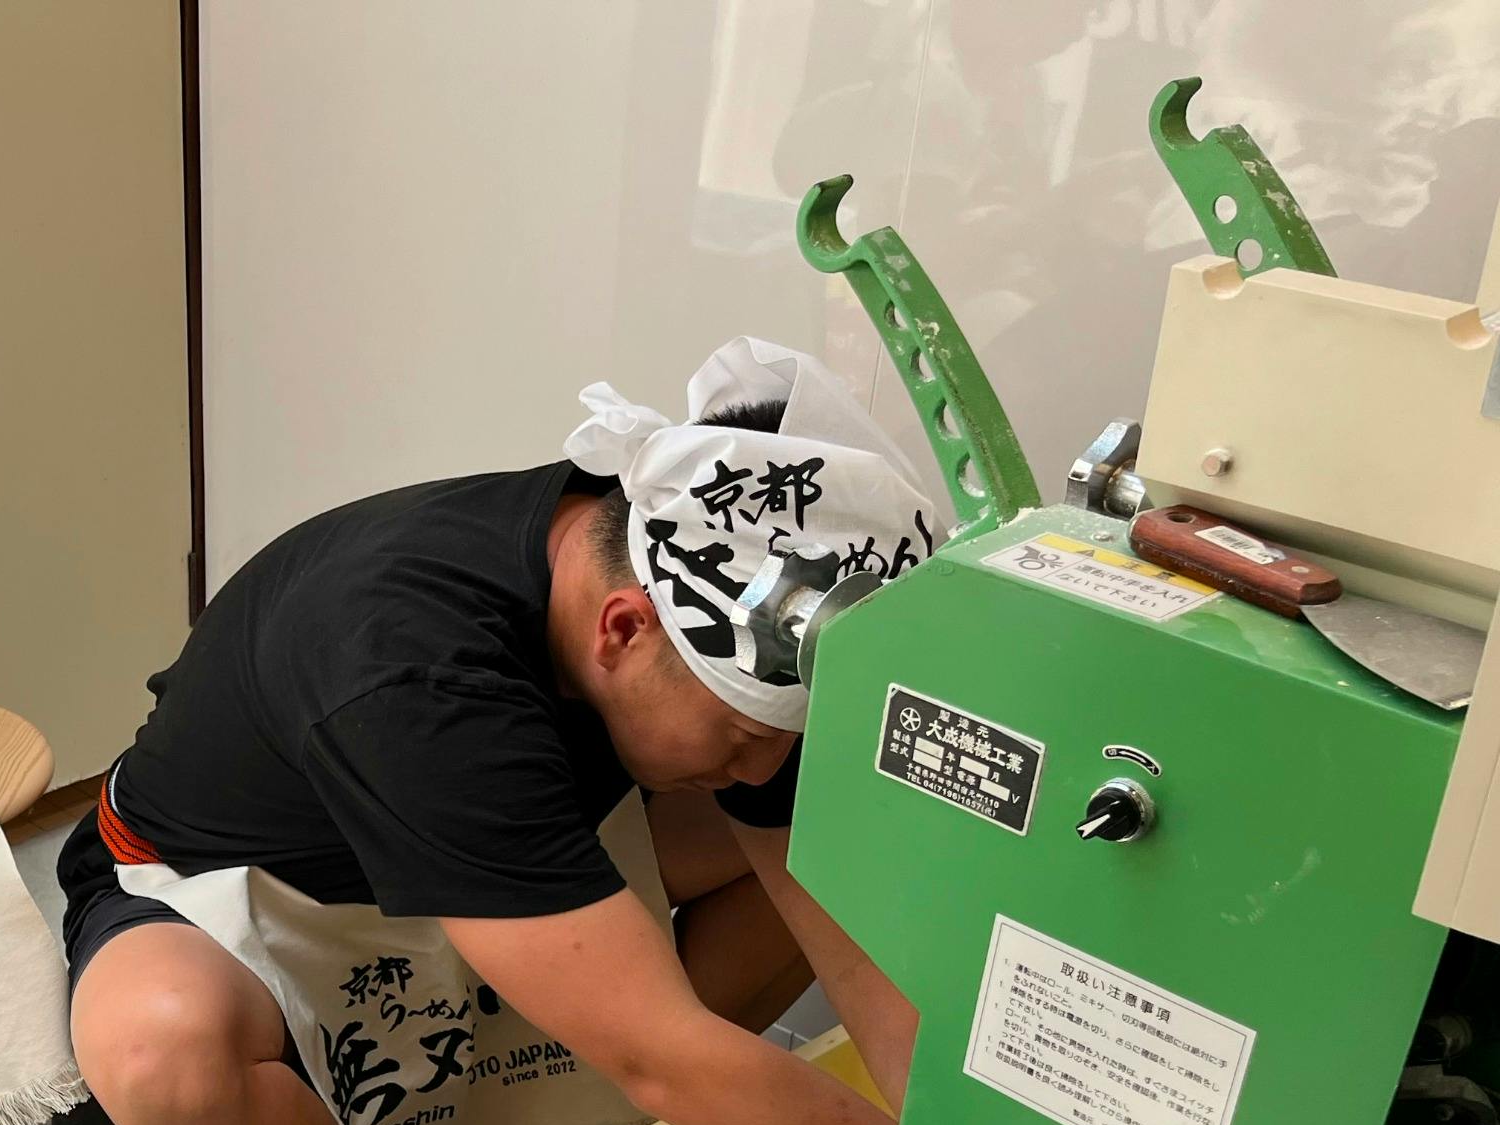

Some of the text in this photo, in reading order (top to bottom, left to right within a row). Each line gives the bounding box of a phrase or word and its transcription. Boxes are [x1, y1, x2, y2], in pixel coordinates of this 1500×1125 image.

[924, 716, 1024, 775] 大成機械工業
[905, 771, 922, 784] TEL
[1010, 793, 1020, 805] V
[1059, 960, 1172, 1024] 取扱い注意事項
[502, 1060, 578, 1087] since 2012
